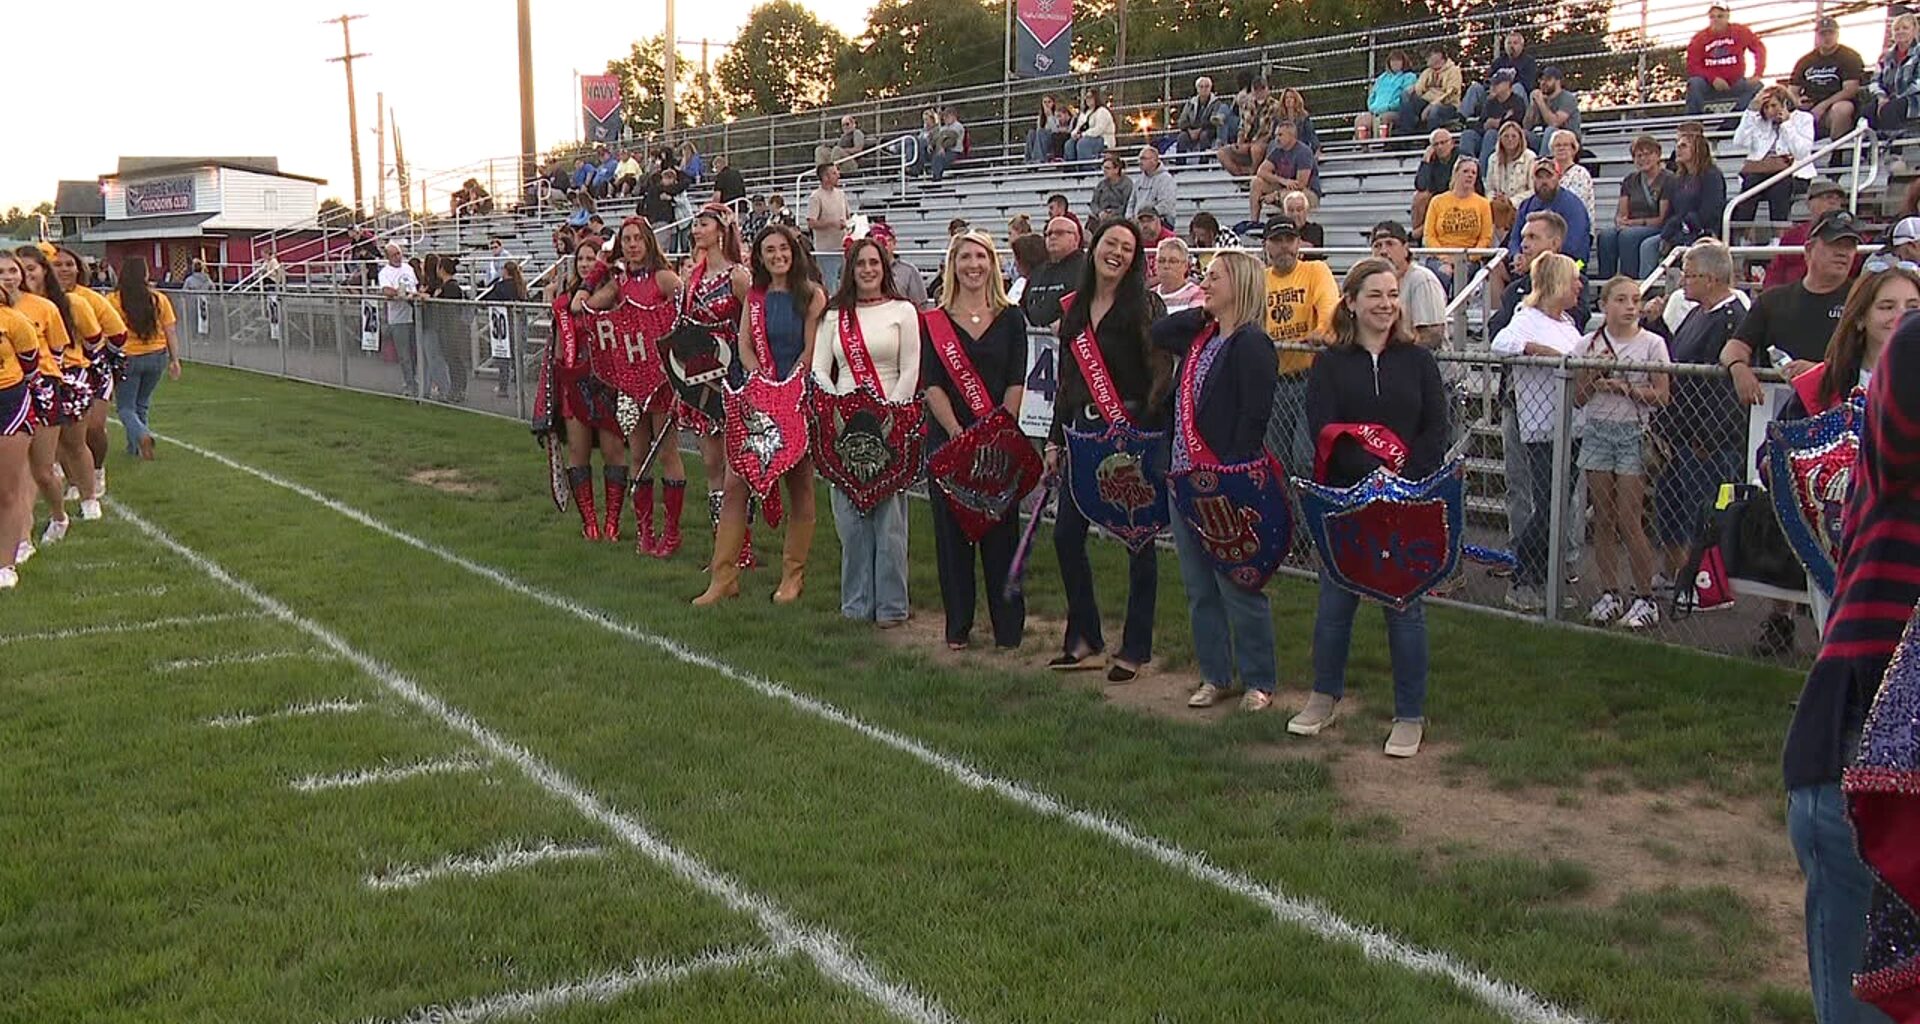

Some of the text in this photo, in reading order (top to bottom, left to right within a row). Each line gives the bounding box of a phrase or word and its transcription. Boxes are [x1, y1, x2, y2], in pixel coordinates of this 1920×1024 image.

[1276, 288, 1305, 304] FIGHT
[364, 305, 377, 333] 25
[491, 313, 507, 340] 30
[848, 333, 866, 372] Viking
[942, 341, 984, 412] Miss Viking
[1076, 331, 1091, 361] Miss
[1088, 360, 1112, 403] Viking
[1357, 424, 1387, 449] Miss
